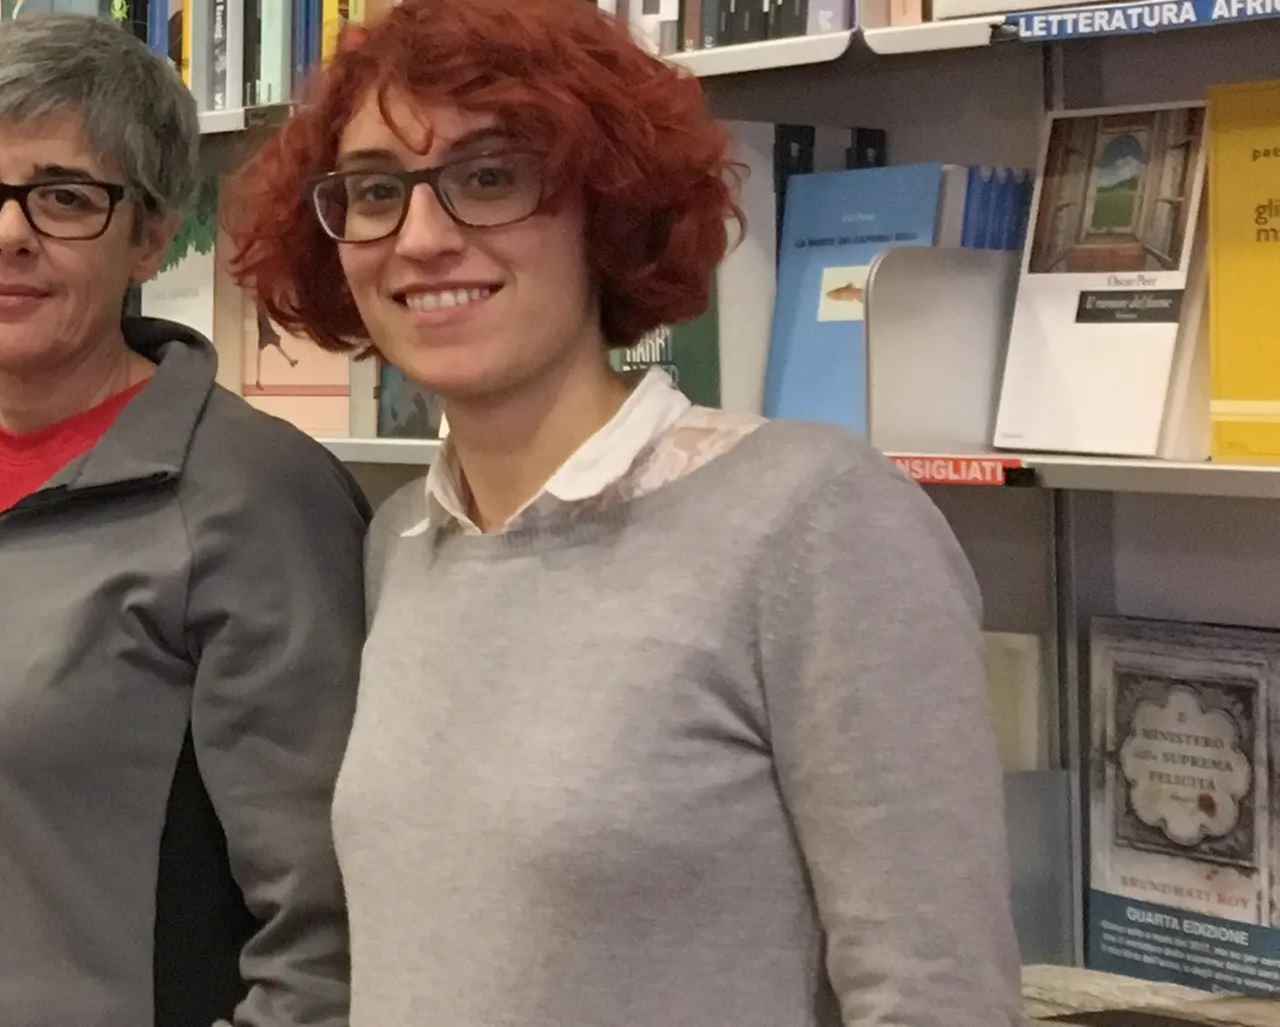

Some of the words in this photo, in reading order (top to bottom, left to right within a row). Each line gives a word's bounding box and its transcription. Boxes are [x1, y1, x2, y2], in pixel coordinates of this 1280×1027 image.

[1019, 2, 1197, 38] LETTERATURA
[896, 458, 1004, 482] NSIGLIATI
[1142, 728, 1225, 749] MINISTERO
[1162, 751, 1234, 772] SUPREMA
[1120, 875, 1211, 902] ARUNDHATI
[1216, 892, 1250, 910] ROY
[1126, 906, 1181, 931] QUARTA
[1182, 919, 1250, 947] EDIZIONE
